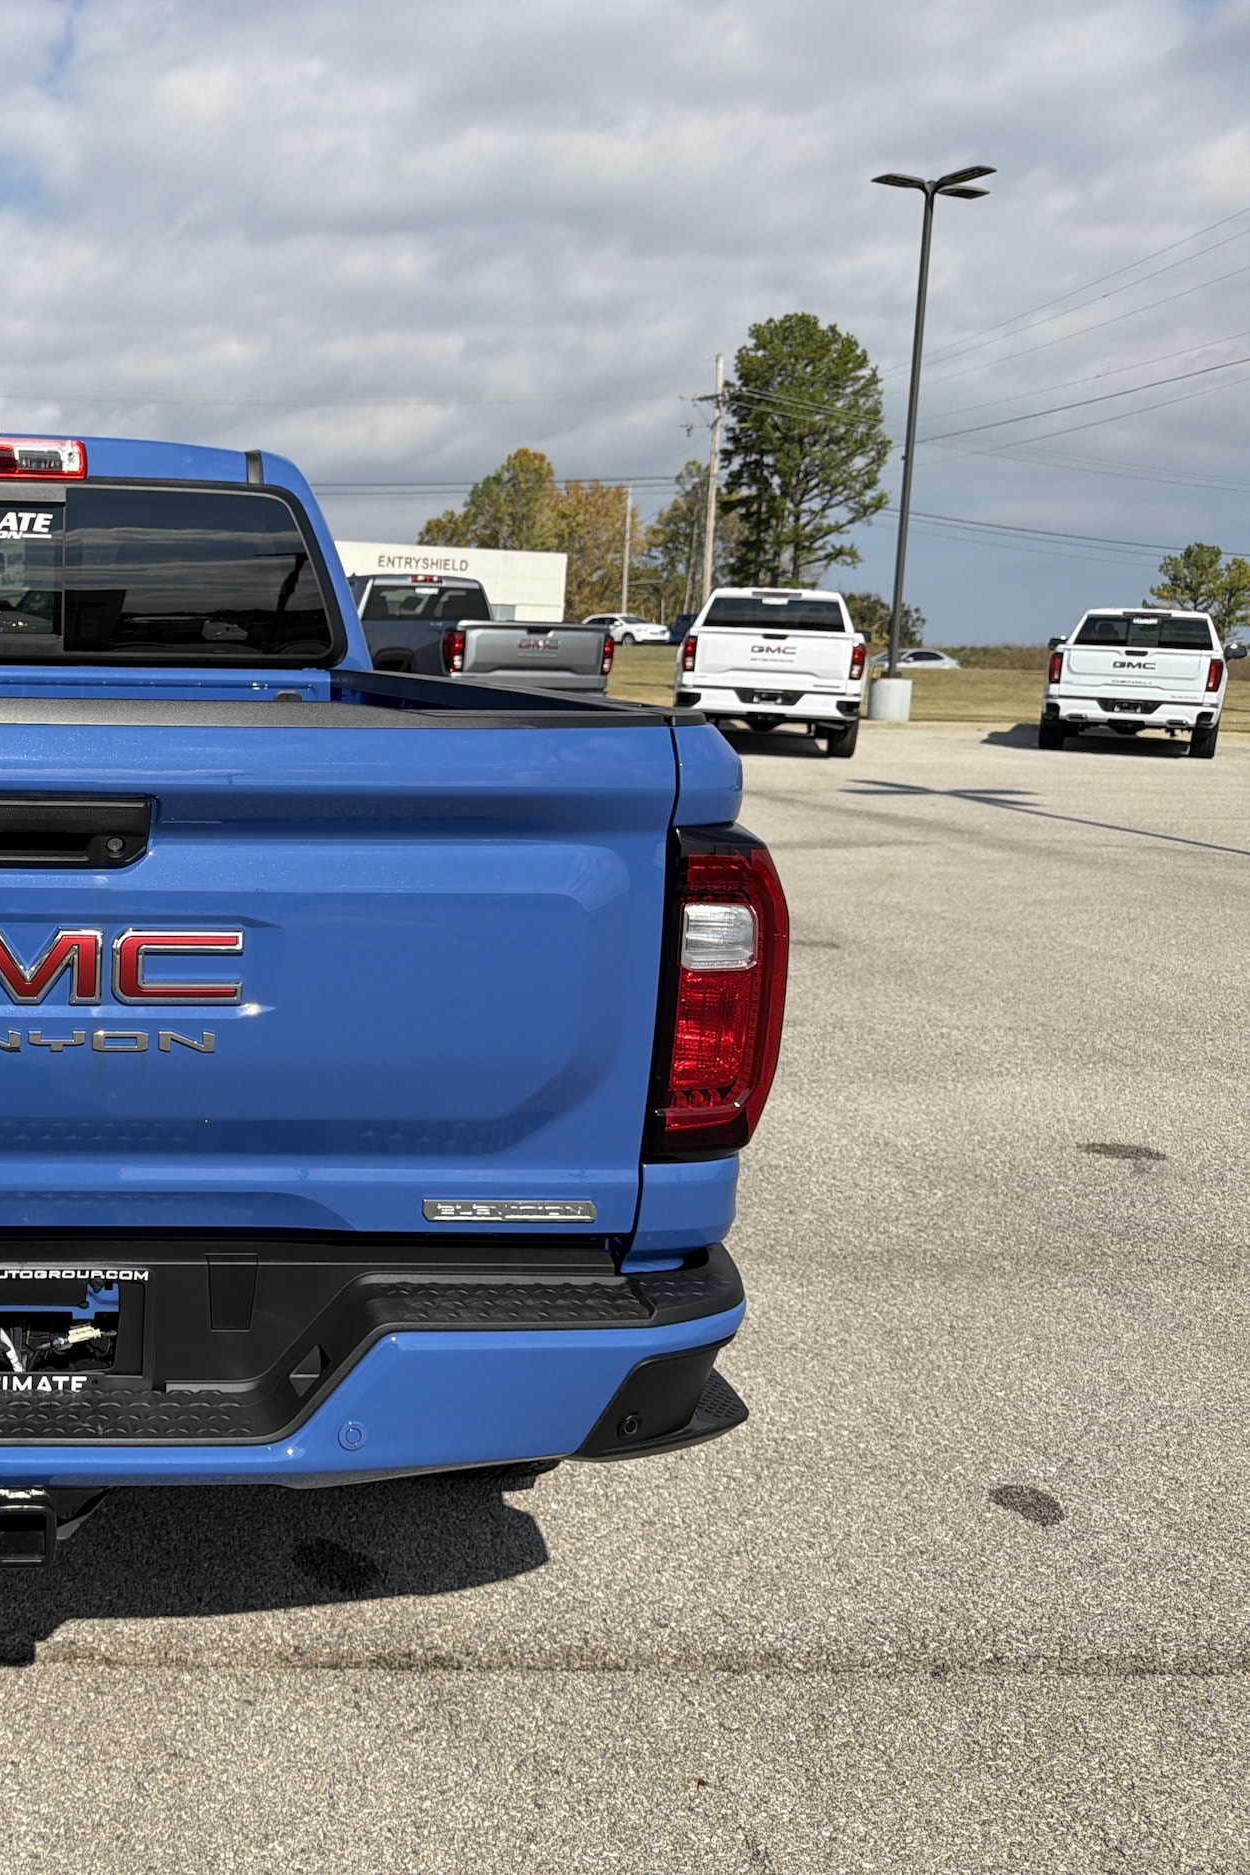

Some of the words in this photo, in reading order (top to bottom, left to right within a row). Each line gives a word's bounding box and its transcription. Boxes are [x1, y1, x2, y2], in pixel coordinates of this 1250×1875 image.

[377, 555, 469, 572] ENTRYSHIELD
[750, 645, 797, 655] GMC
[1112, 661, 1157, 670] GMC
